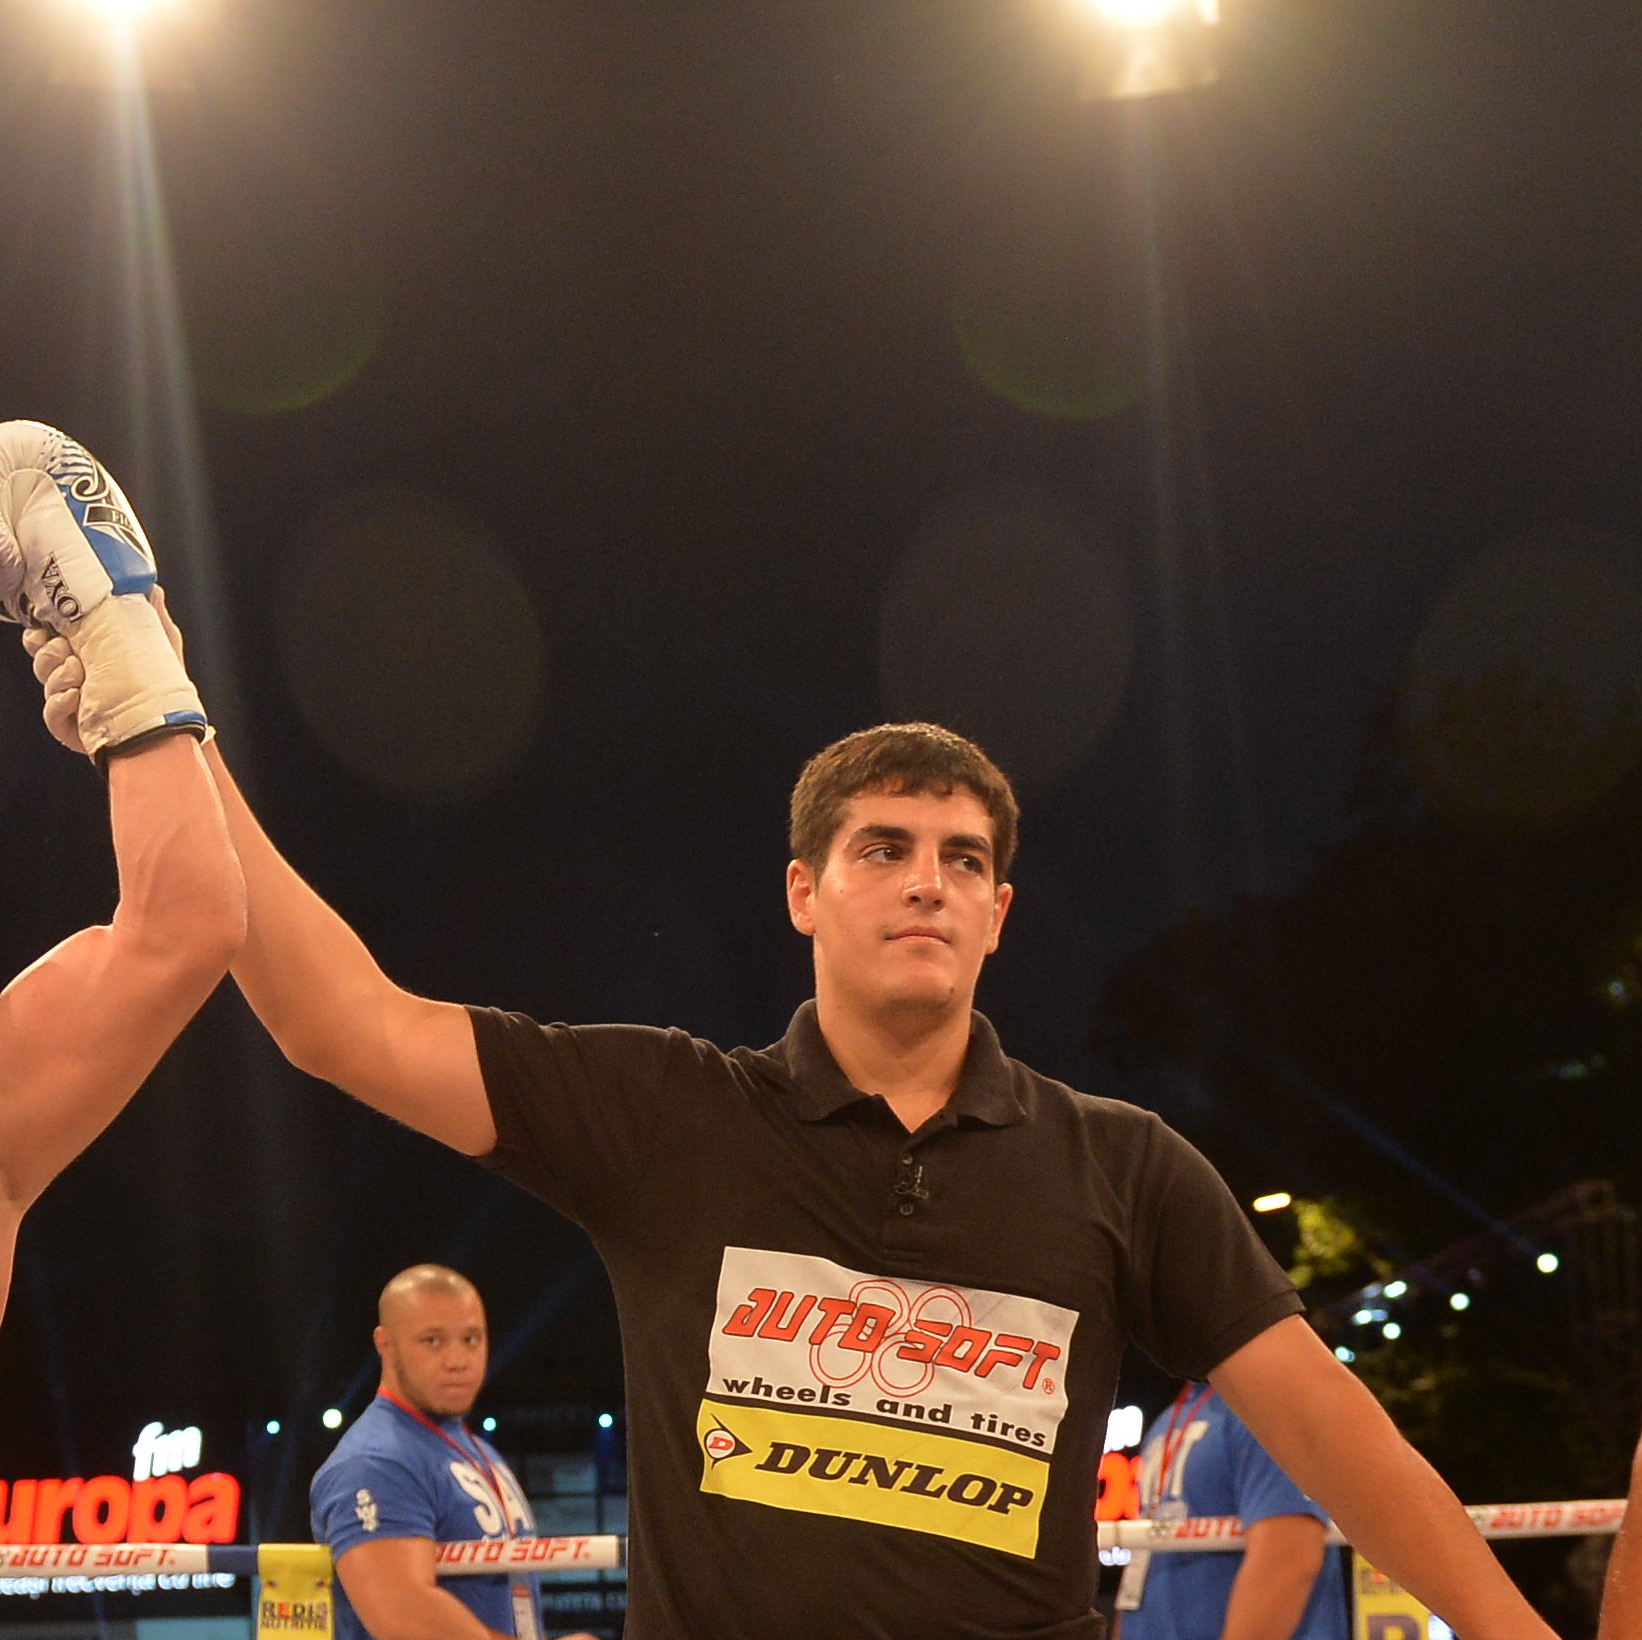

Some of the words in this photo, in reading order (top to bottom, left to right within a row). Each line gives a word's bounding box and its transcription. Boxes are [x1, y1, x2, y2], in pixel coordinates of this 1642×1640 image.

[722, 1287, 896, 1354] AUTO
[722, 1376, 852, 1408] wheels
[876, 1398, 953, 1426] and
[970, 1412, 1048, 1449] tires
[132, 1421, 203, 1482] fm
[753, 1440, 1035, 1517] DUNLOP
[1569, 1506, 1627, 1527] SOF
